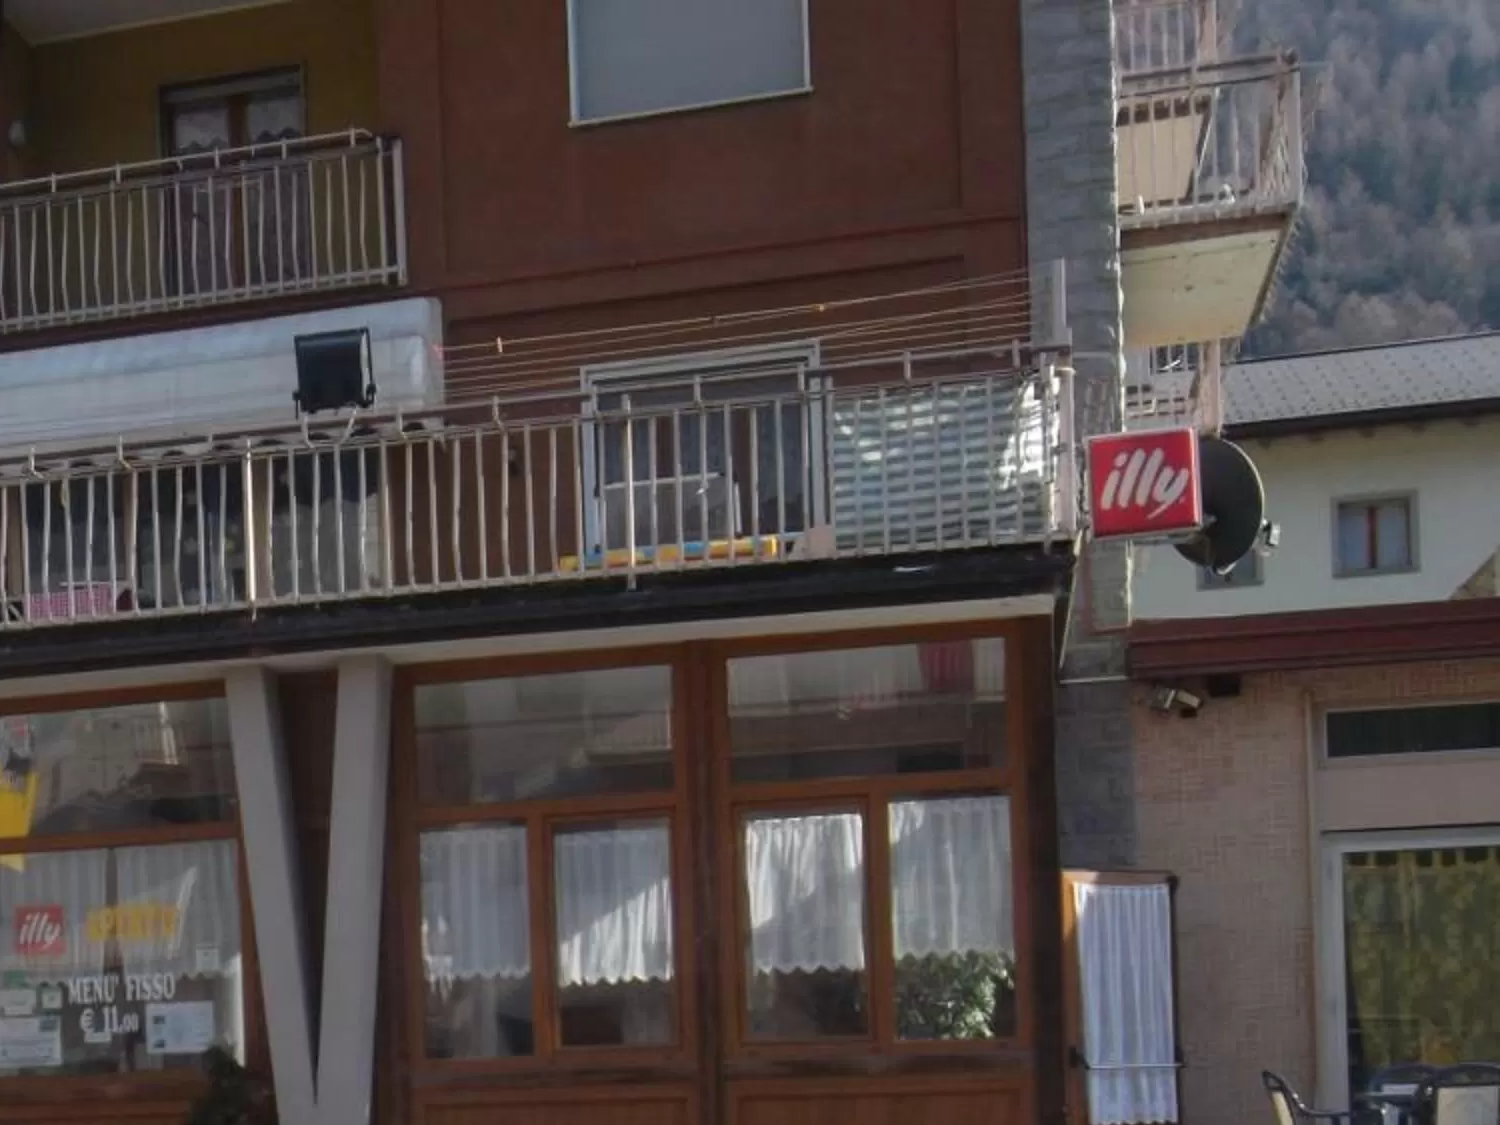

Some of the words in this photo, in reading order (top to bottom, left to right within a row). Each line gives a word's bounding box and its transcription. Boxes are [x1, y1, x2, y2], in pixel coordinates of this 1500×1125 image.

[1101, 448, 1190, 519] illy
[19, 911, 62, 950] illy
[125, 972, 176, 1001] FISSO
